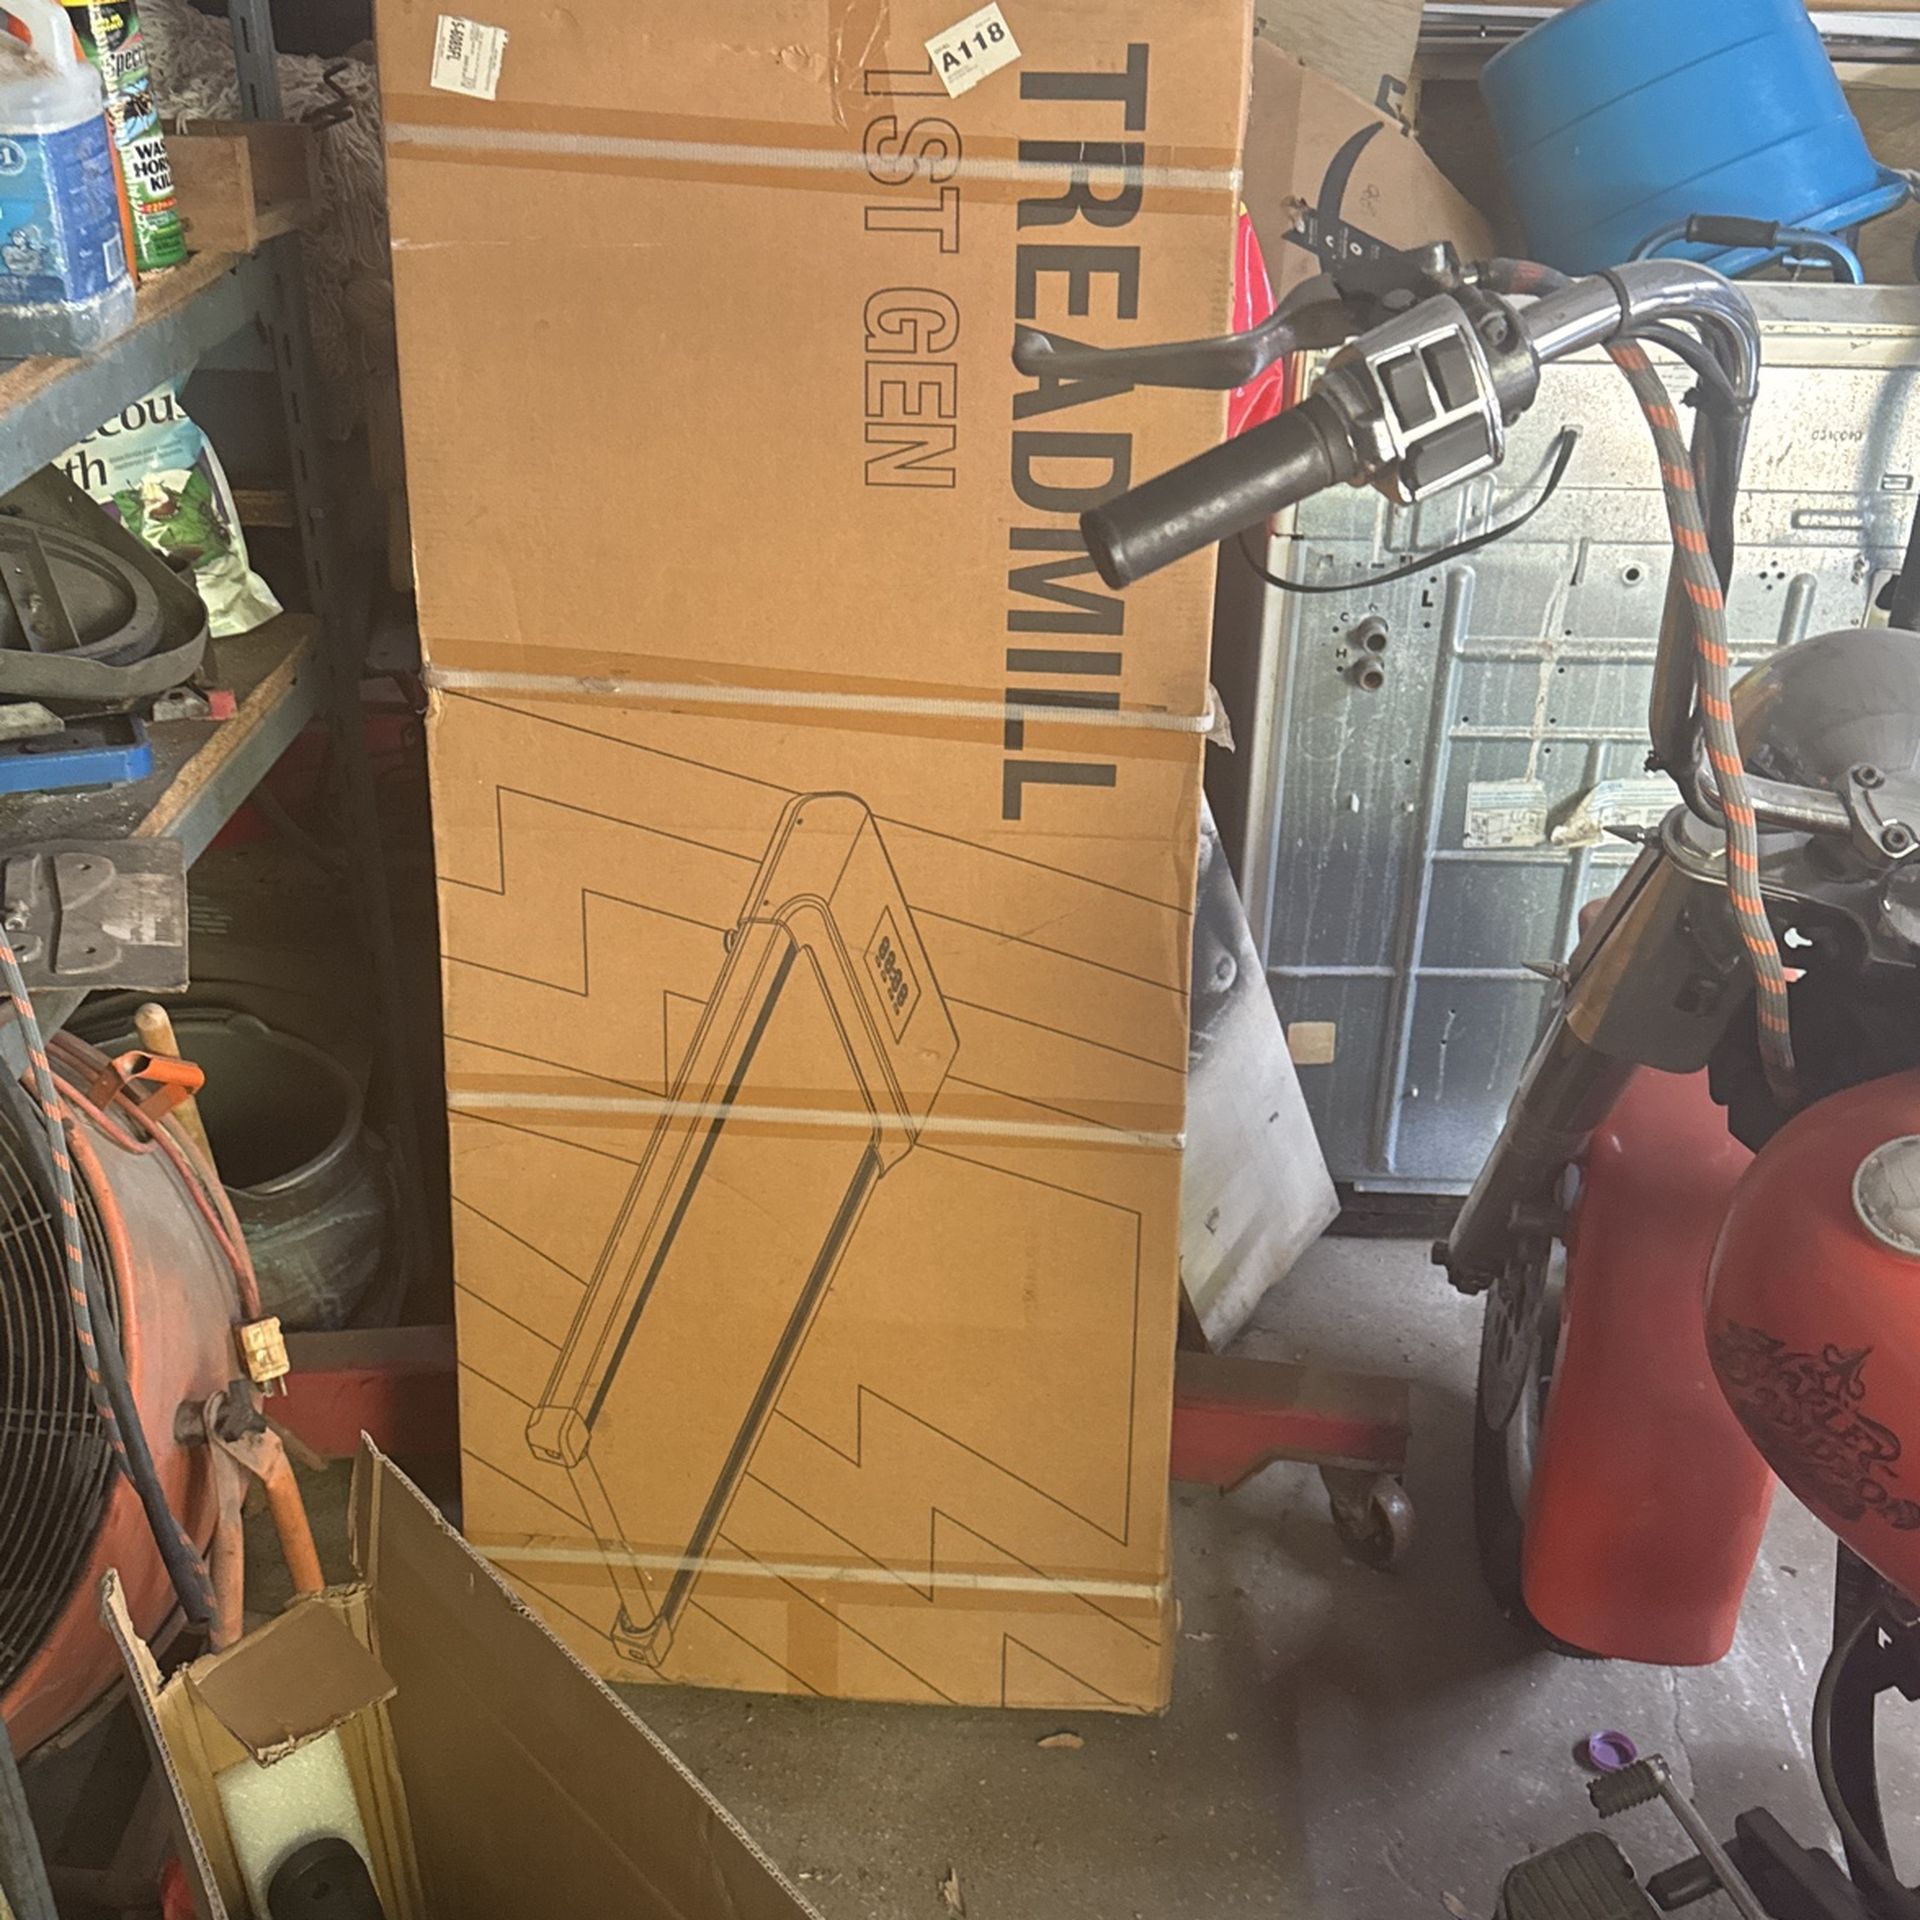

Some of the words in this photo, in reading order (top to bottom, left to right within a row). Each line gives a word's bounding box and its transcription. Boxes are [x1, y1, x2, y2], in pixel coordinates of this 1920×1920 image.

[942, 21, 1005, 73] A118
[863, 286, 960, 489] GEN
[1003, 42, 1149, 820] TREADMILL
